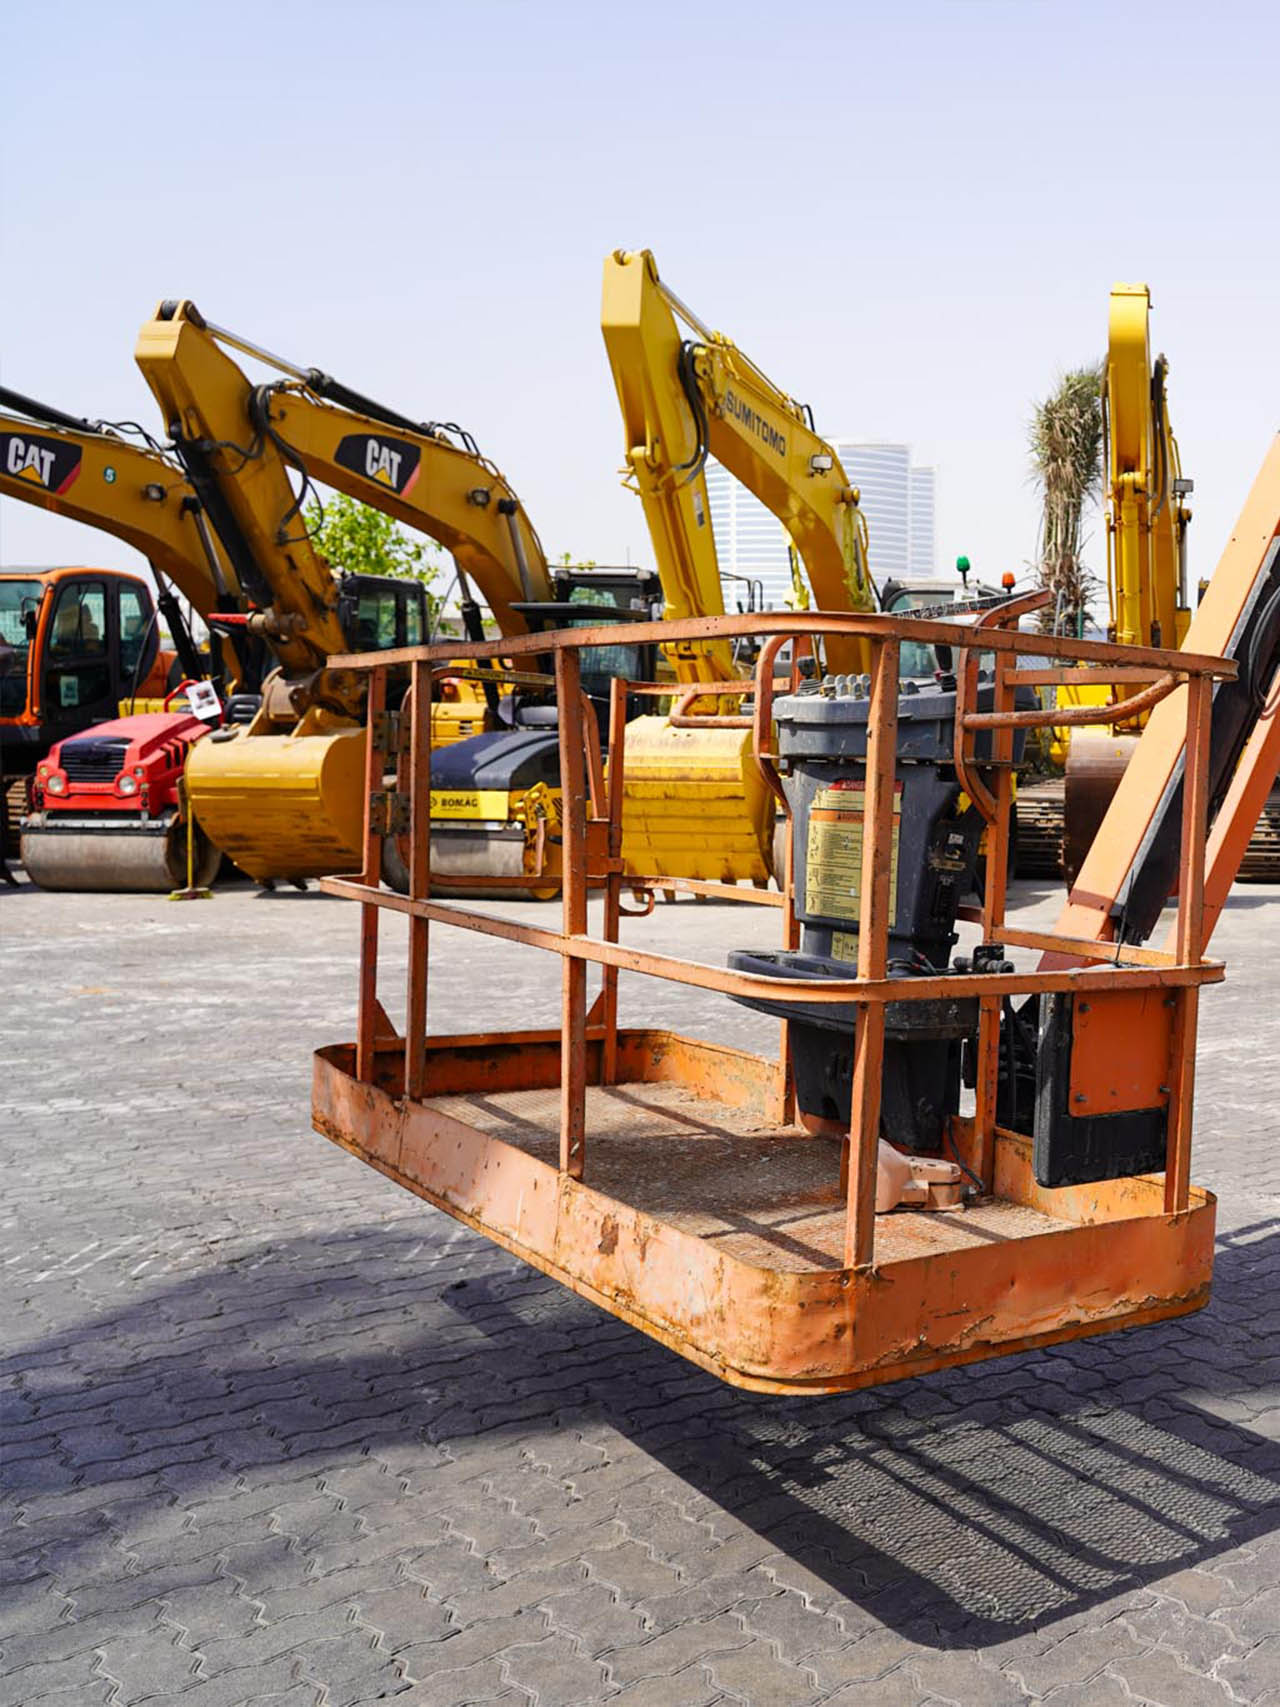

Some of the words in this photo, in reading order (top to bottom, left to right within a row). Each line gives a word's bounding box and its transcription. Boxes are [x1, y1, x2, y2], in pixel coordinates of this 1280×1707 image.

[726, 391, 786, 456] SUMITOMO
[7, 437, 56, 486] CAT
[366, 439, 402, 488] CAT
[441, 798, 478, 807] BOMAG
